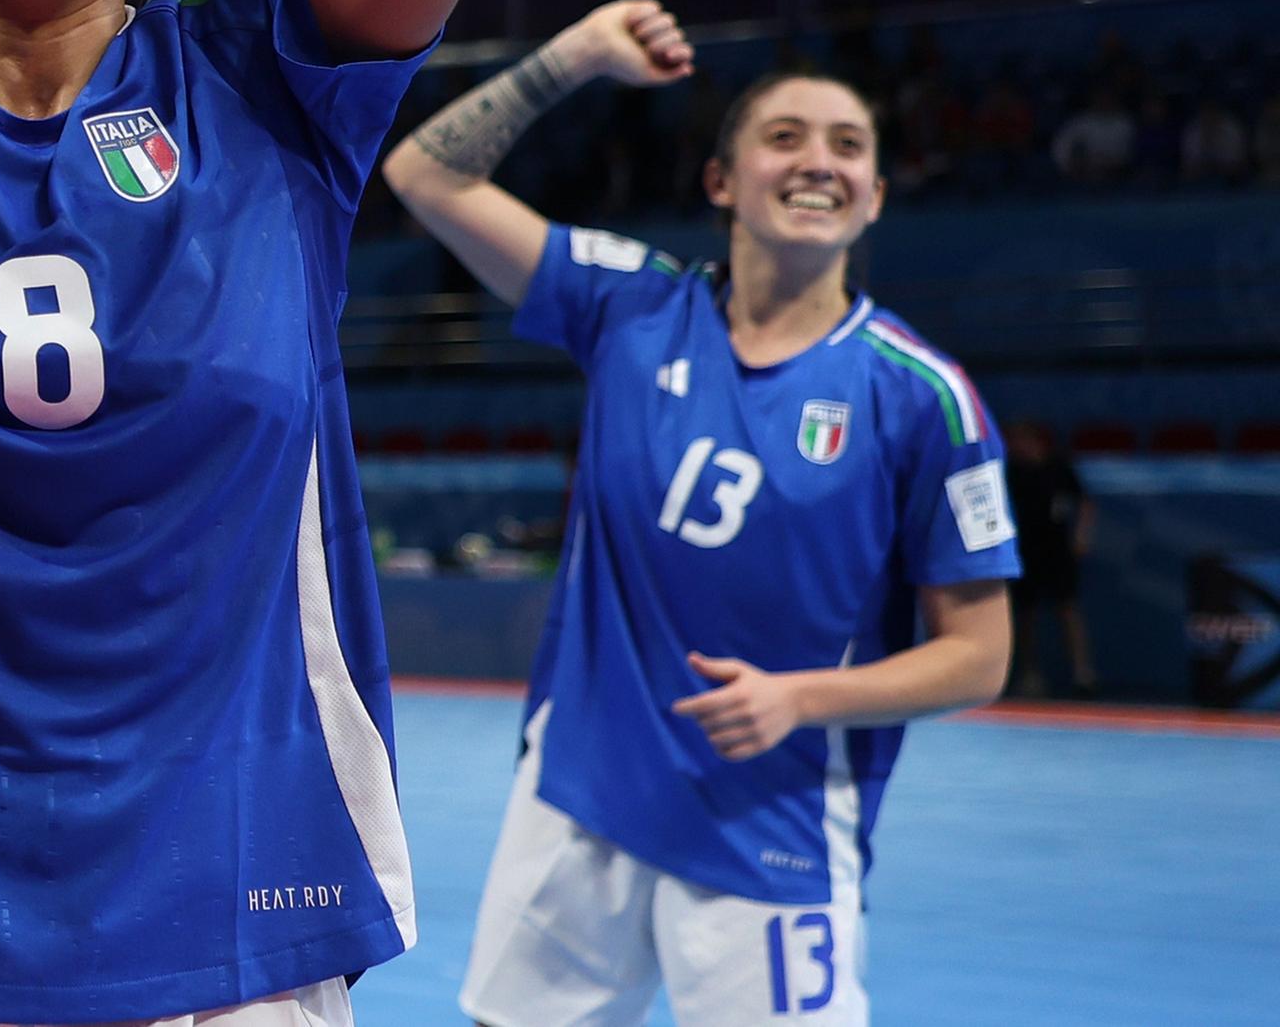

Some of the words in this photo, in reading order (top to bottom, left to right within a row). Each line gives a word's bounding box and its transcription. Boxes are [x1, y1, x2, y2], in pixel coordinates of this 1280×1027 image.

[90, 116, 155, 142] ITALIA
[657, 436, 765, 549] 13
[248, 885, 342, 911] HEAT.RDY
[765, 911, 835, 1014] 13
